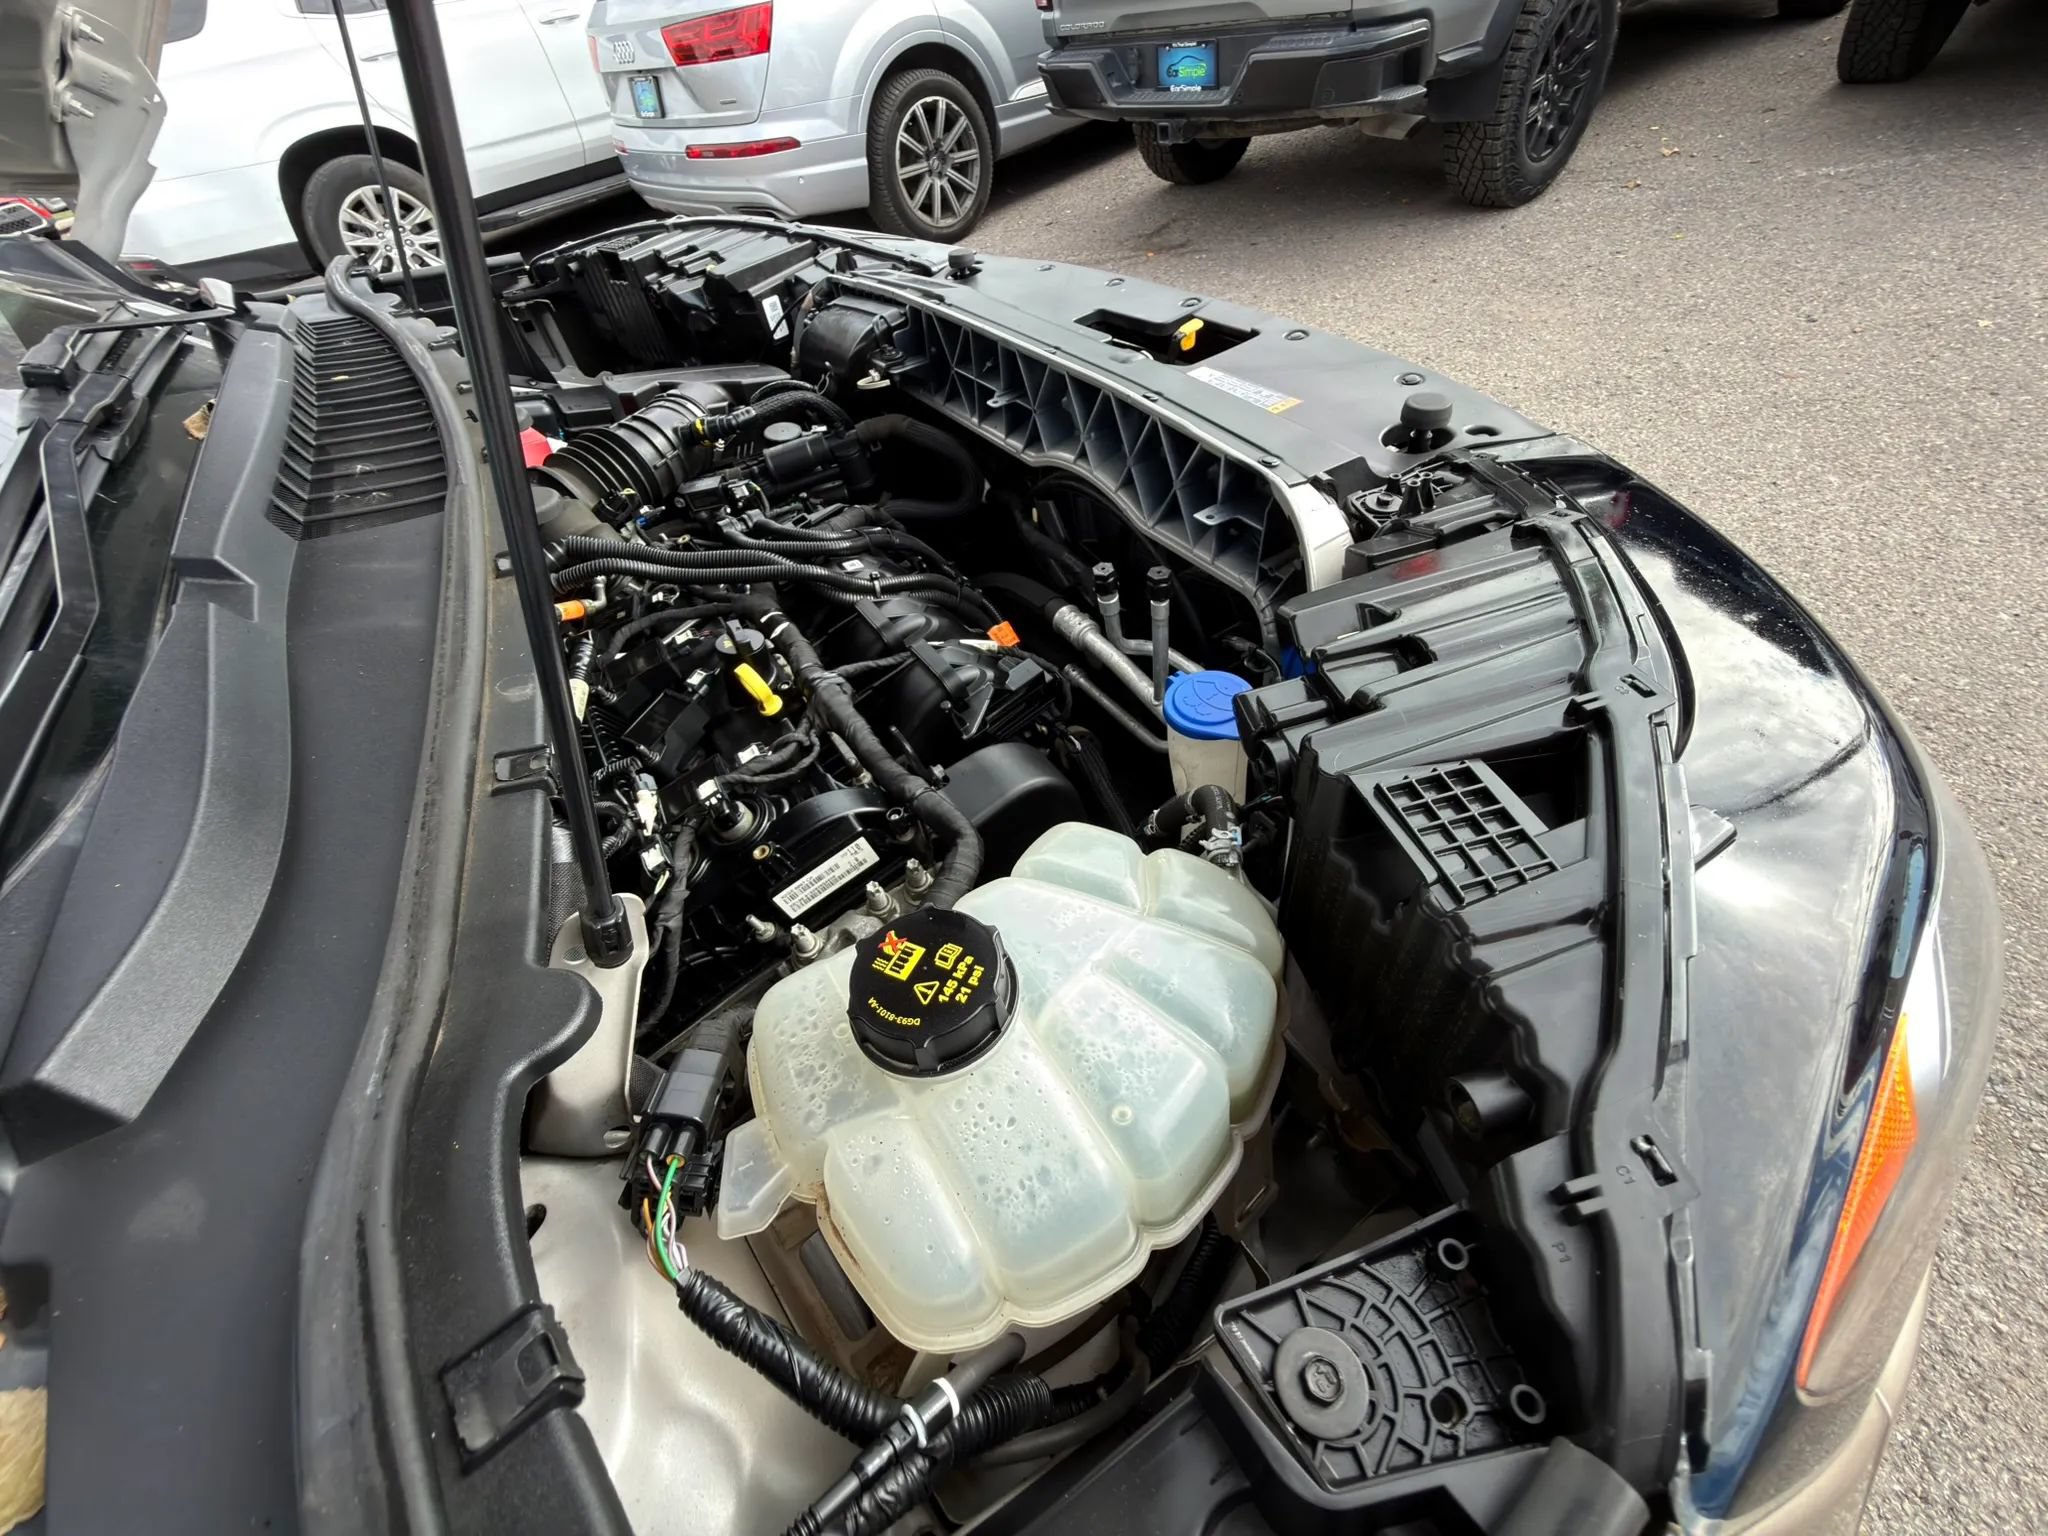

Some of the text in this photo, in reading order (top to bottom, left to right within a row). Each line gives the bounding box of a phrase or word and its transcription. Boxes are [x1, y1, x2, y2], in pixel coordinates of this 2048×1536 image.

[1060, 21, 1104, 31] COLORADO
[938, 955, 975, 1003] 145 kPa
[955, 965, 985, 1004] 21 psi
[867, 996, 921, 1026] DG93-8101-AA
